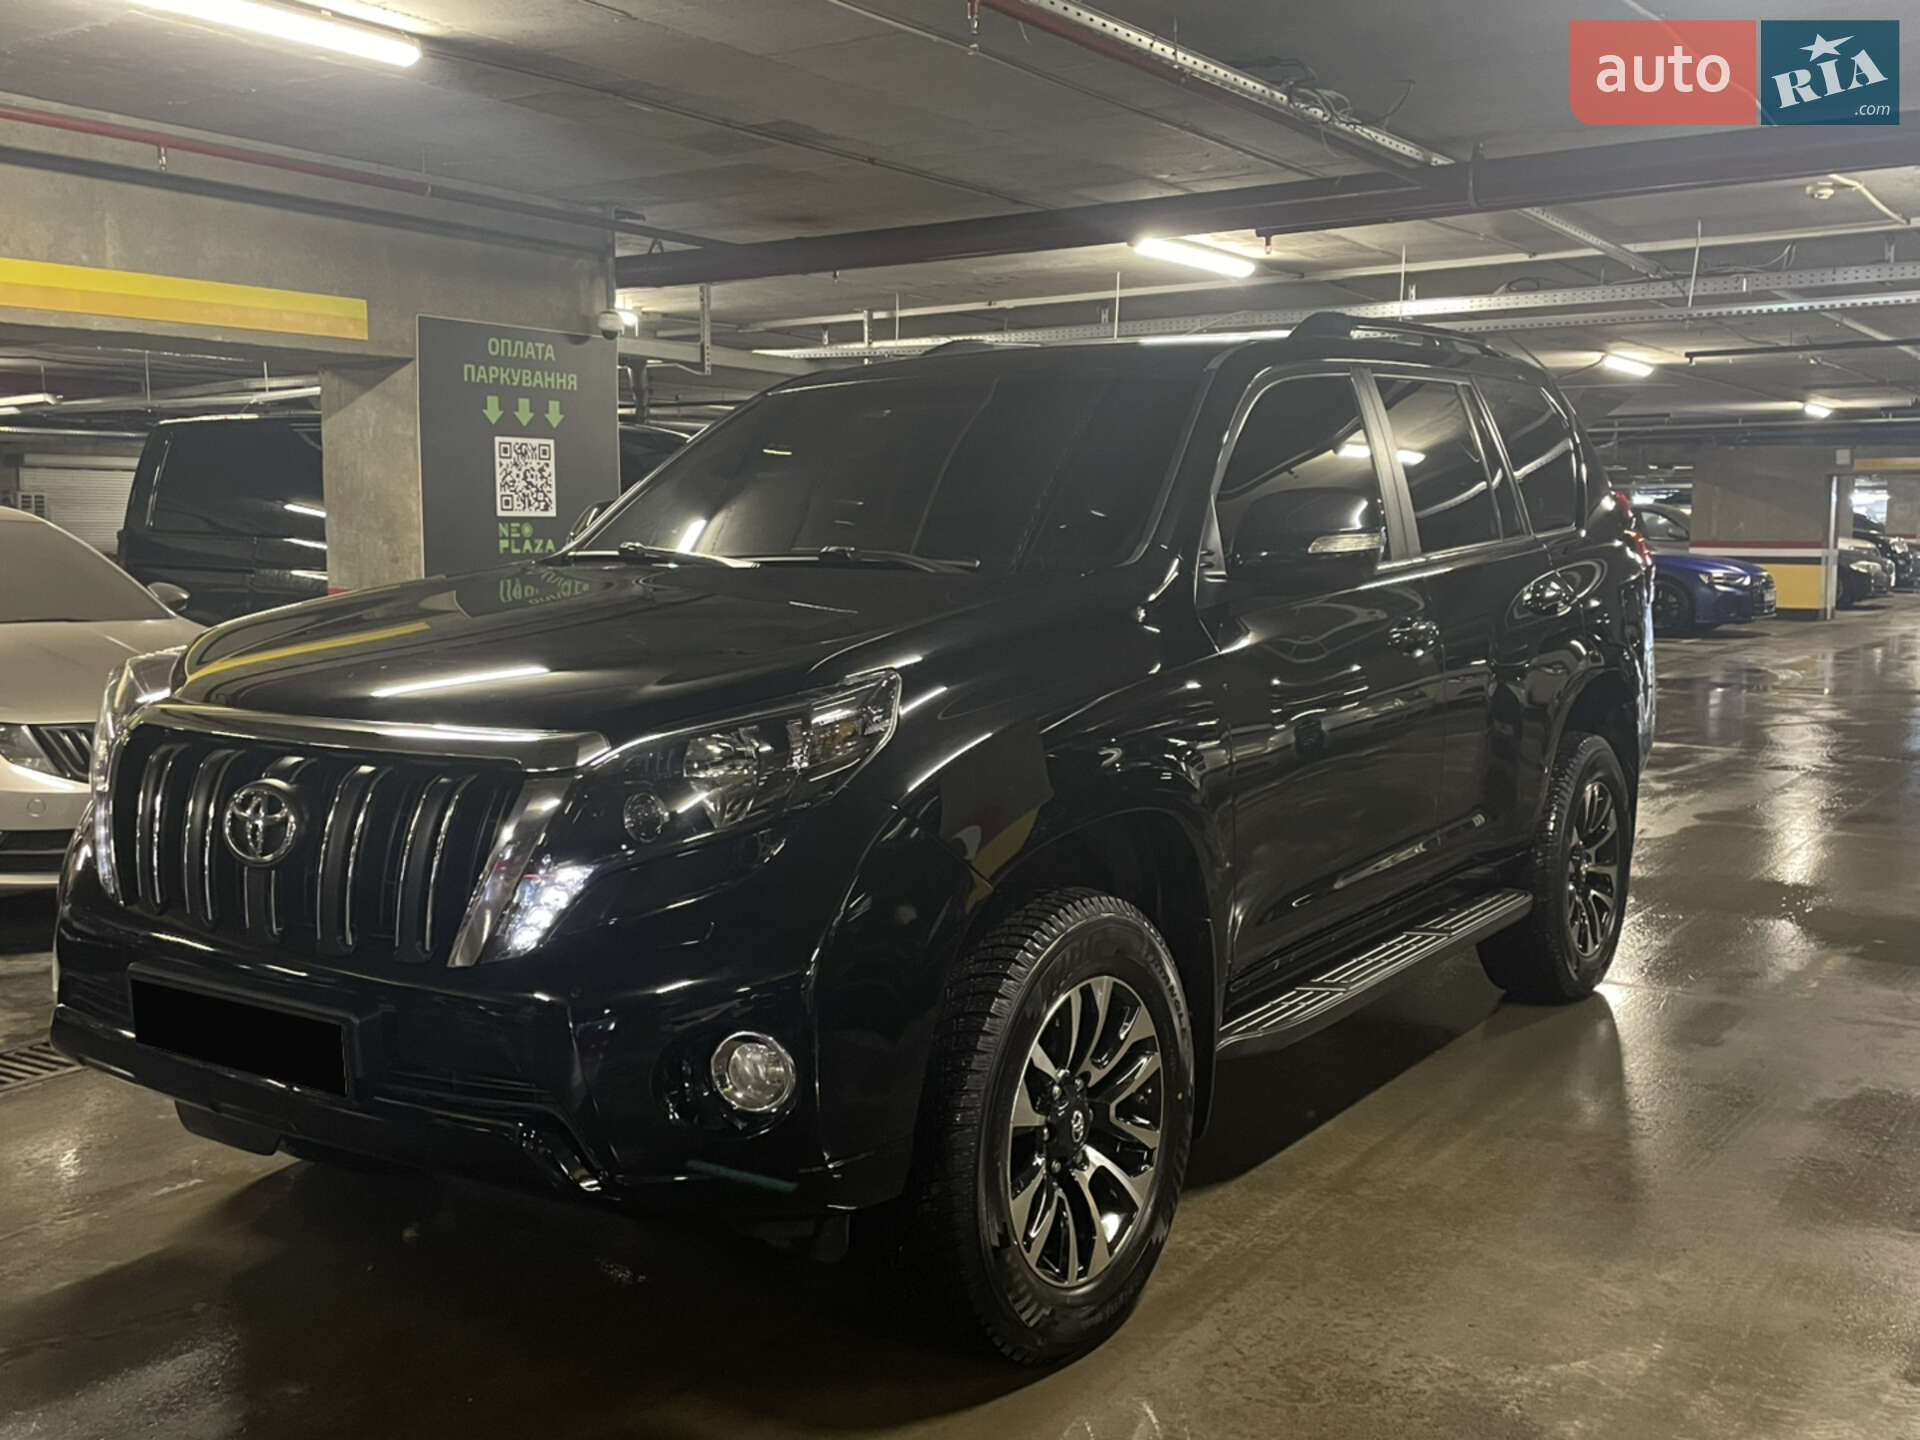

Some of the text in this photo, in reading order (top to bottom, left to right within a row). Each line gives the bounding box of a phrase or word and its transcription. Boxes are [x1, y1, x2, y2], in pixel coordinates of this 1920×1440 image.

[487, 337, 556, 361] ОПЛАТА
[463, 363, 578, 391] ПАРКУВАННЯ
[498, 522, 534, 538] NEO
[499, 538, 557, 554] PLAZA
